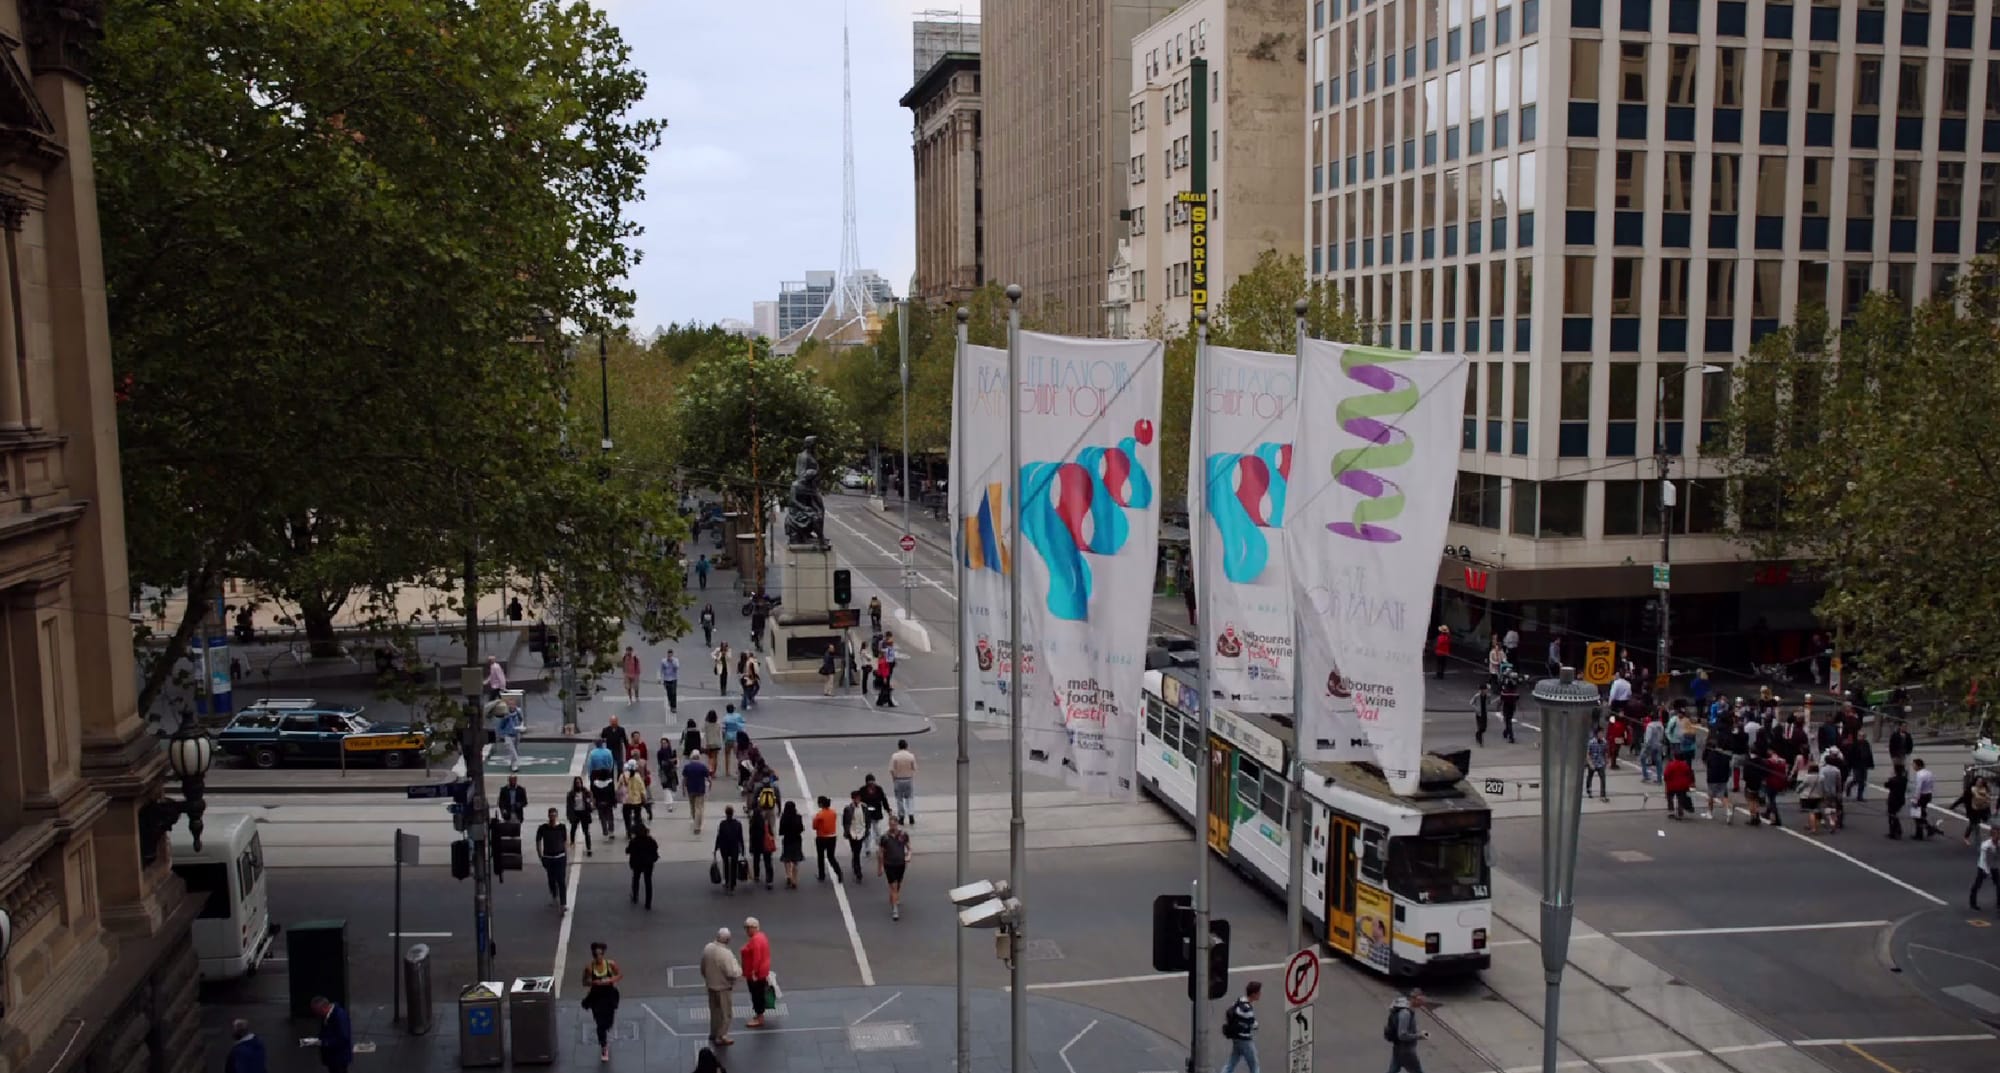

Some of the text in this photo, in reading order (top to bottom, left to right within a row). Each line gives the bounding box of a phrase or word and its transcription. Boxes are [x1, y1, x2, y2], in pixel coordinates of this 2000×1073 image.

[1192, 207, 1206, 283] SPORTS
[1594, 662, 1605, 675] 15
[1066, 691, 1099, 706] food
